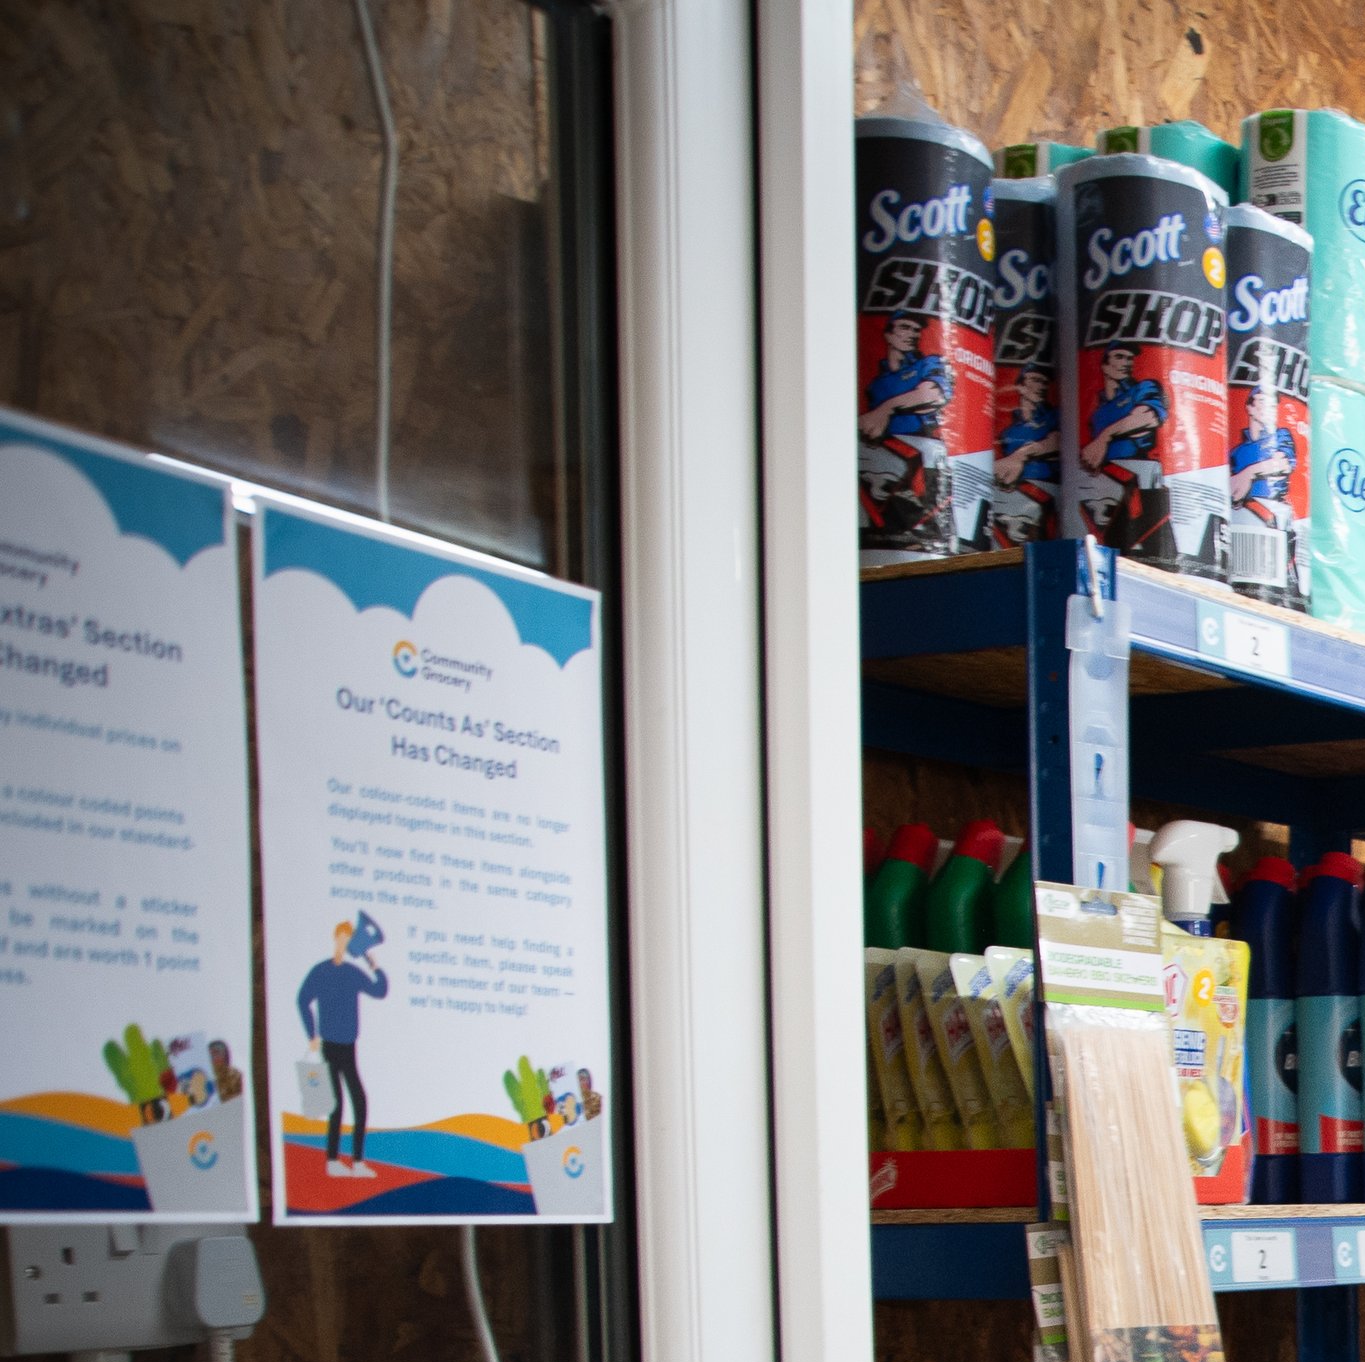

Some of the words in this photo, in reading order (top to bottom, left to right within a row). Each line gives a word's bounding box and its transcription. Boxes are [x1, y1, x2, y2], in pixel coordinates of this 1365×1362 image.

[863, 185, 972, 252] Scott
[1084, 214, 1186, 290] Scott
[1085, 289, 1226, 354] SHOP
[1229, 276, 1309, 331] Scott
[0, 640, 109, 687] hanged
[83, 618, 183, 663] Section
[420, 648, 493, 681] Community
[421, 665, 472, 693] Grocery
[336, 687, 375, 714] Our
[493, 722, 561, 754] Section
[391, 735, 430, 762] Has
[434, 745, 518, 779] Changed
[1198, 976, 1211, 1000] 2
[1258, 1249, 1268, 1270] 2
